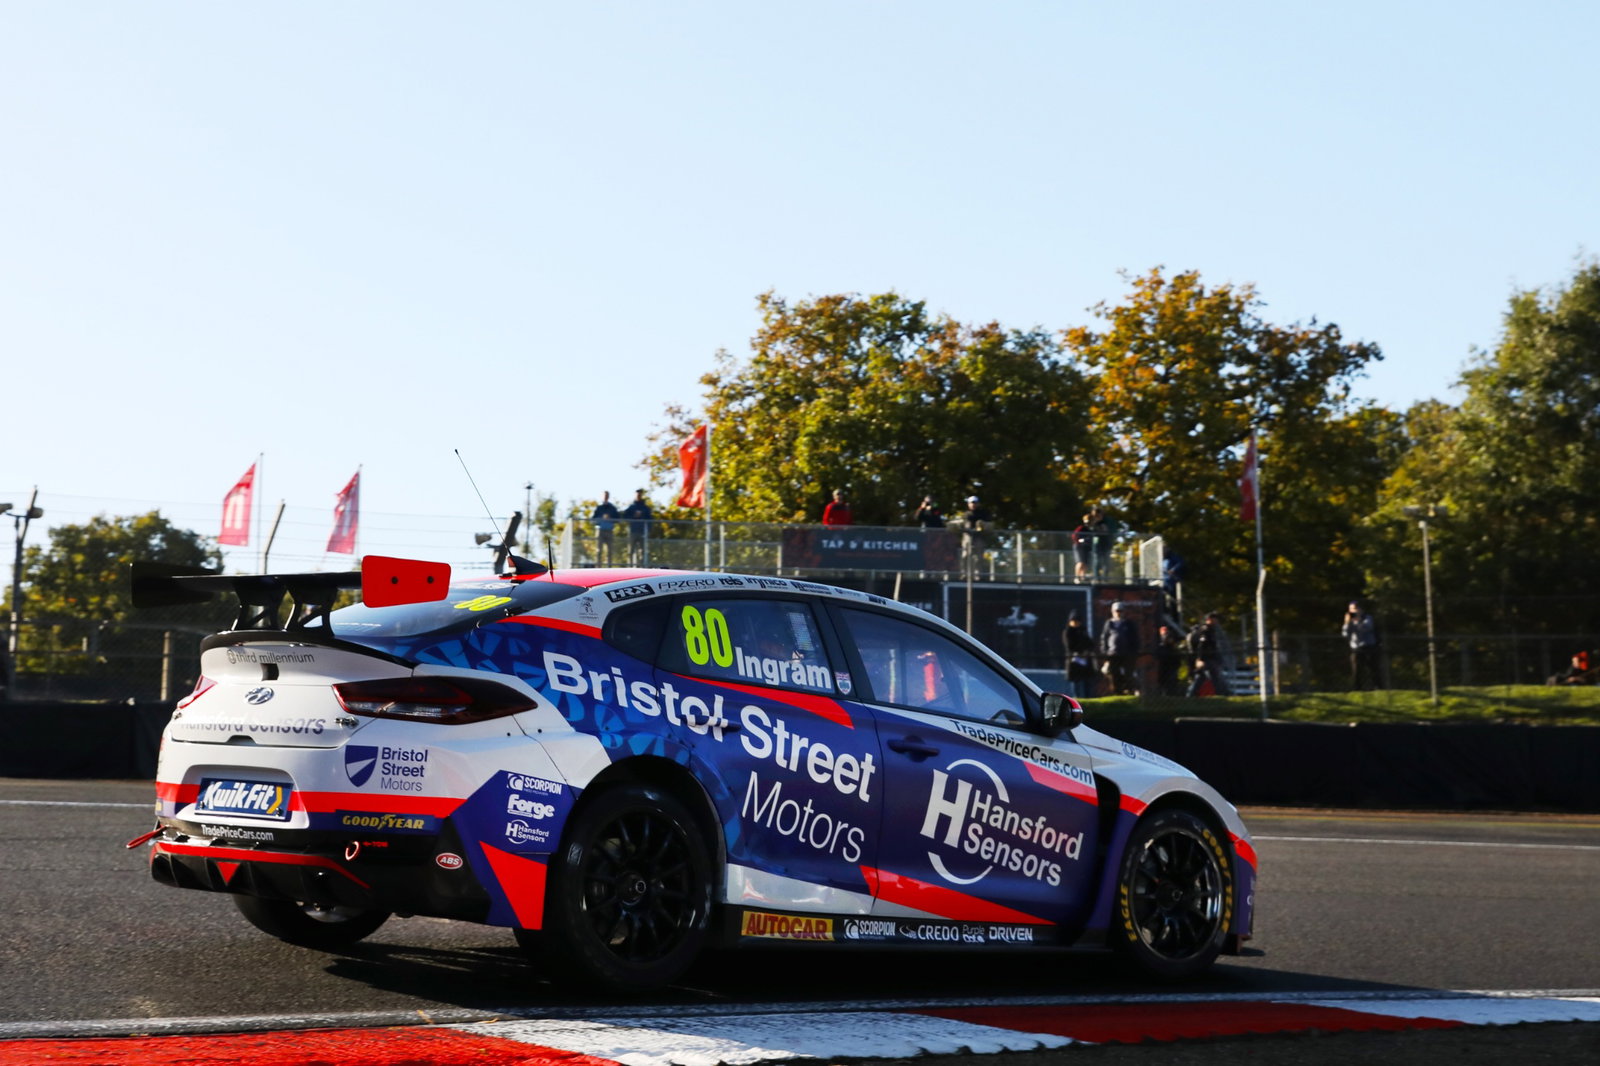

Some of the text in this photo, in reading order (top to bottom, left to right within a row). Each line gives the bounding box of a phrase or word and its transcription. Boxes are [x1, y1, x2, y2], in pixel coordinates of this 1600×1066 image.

[822, 539, 918, 551] TAP & KITCHEN
[609, 585, 650, 600] HRX
[682, 605, 733, 668] 80
[236, 651, 315, 665] third millennium
[735, 647, 832, 690] Ingram
[543, 651, 876, 803] Bristol Street
[382, 747, 428, 764] Bristol
[953, 720, 1093, 785] TradePriceCars.com
[382, 761, 425, 778] Street
[381, 776, 423, 792] Motors
[524, 777, 562, 795] SCORPION
[508, 794, 555, 820] Forge
[920, 768, 972, 849] H
[742, 771, 865, 863] Motors
[971, 790, 1084, 861] Hansford
[201, 824, 274, 841] TradePriceCars.com
[518, 825, 549, 837] Hansford
[518, 831, 545, 843] Sensors
[440, 856, 460, 866] ABS
[964, 824, 1062, 887] Sensors
[1120, 884, 1137, 942] EAGLE
[746, 912, 829, 941] AUTOCAR
[860, 920, 896, 936] SCORPION
[918, 925, 959, 942] CREDO
[962, 924, 985, 935] Purple
[989, 926, 1033, 942] DRIVEN
